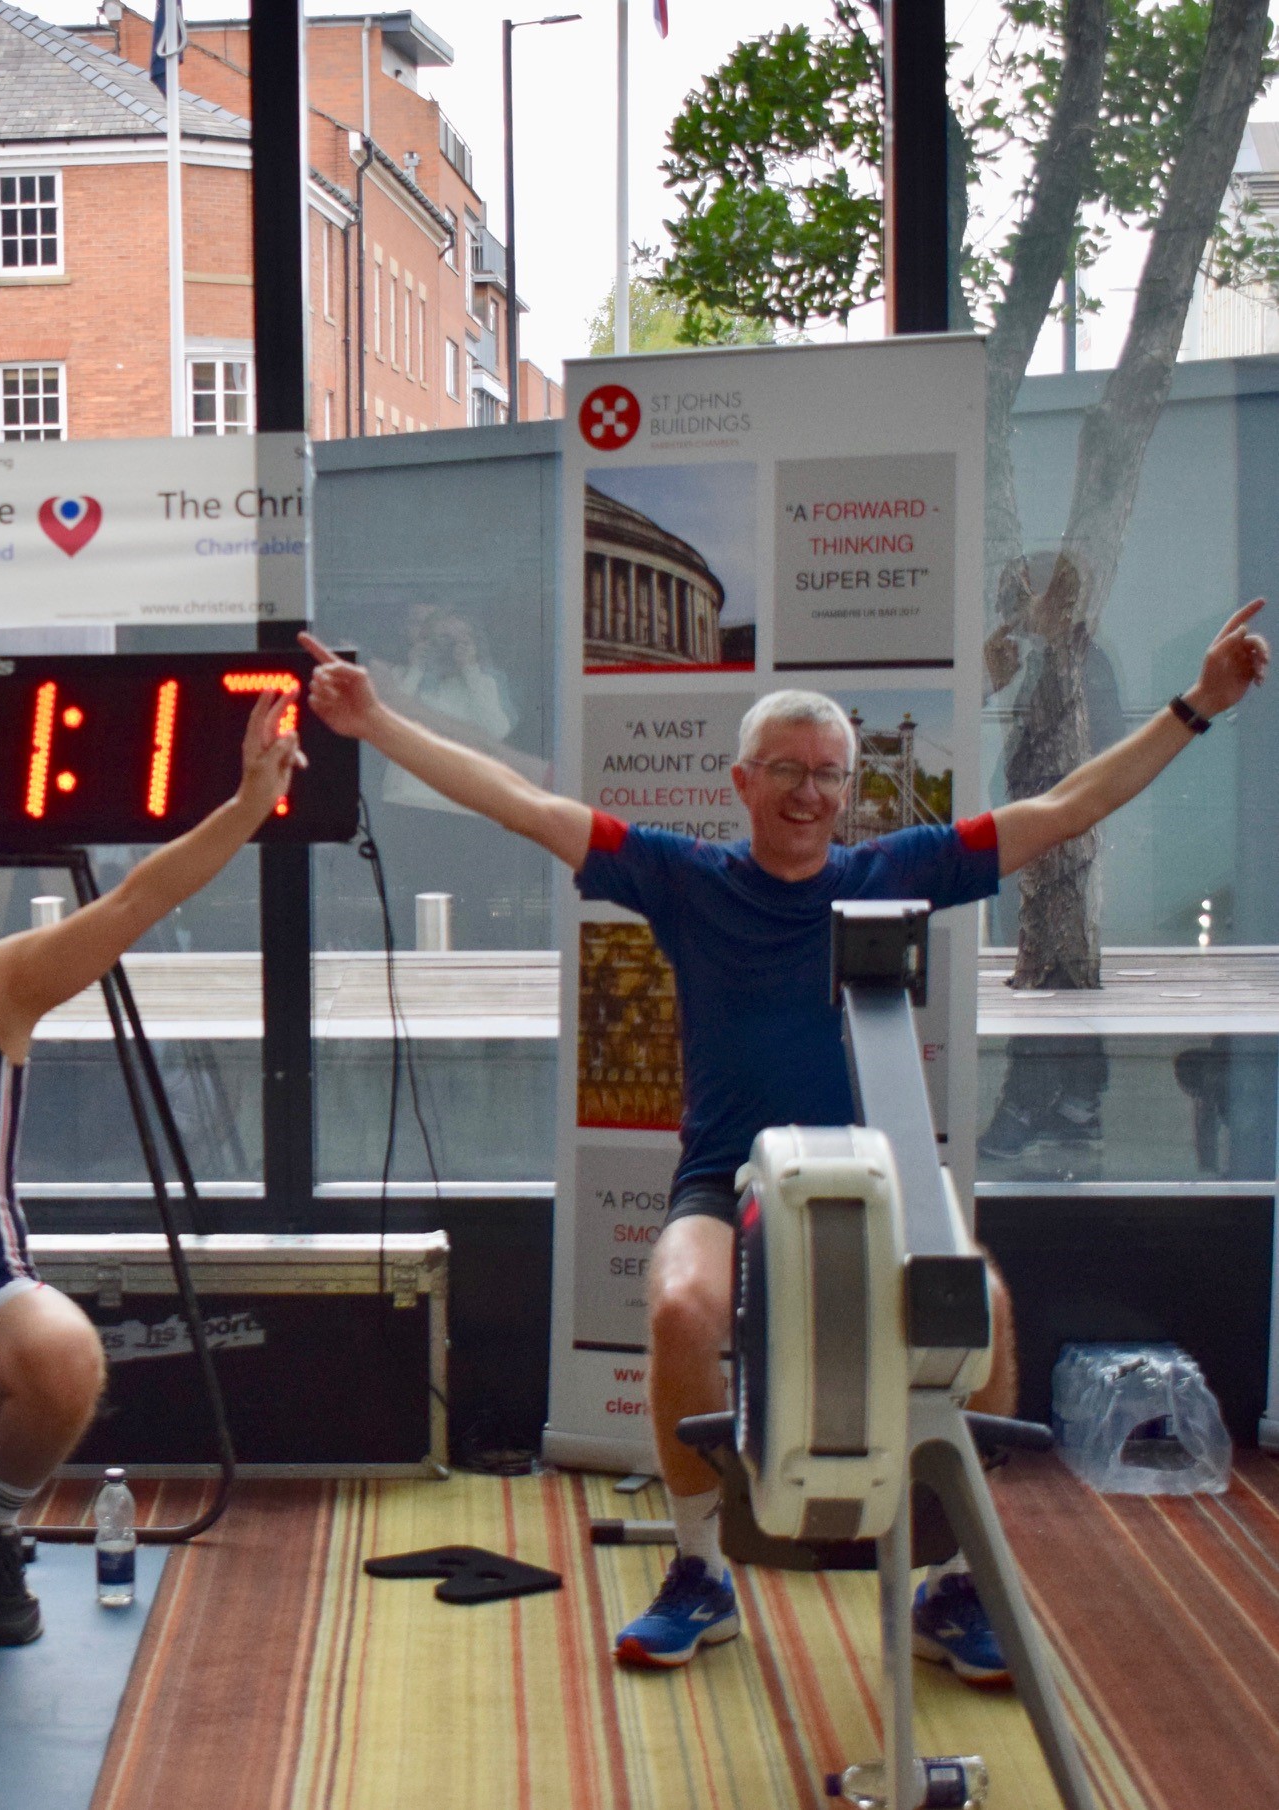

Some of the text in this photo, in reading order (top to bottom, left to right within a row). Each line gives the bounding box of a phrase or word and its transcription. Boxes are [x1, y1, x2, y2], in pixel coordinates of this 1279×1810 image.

[650, 391, 742, 415] ST JOHNS
[650, 413, 751, 436] BUILDINGS
[158, 492, 221, 519] The
[812, 499, 926, 521] FORWARD
[808, 533, 914, 556] THINKING
[795, 569, 870, 591] SUPER
[652, 719, 707, 739] VAST
[603, 753, 731, 773] AMOUNT OF
[599, 787, 732, 807] COLLECTIVE
